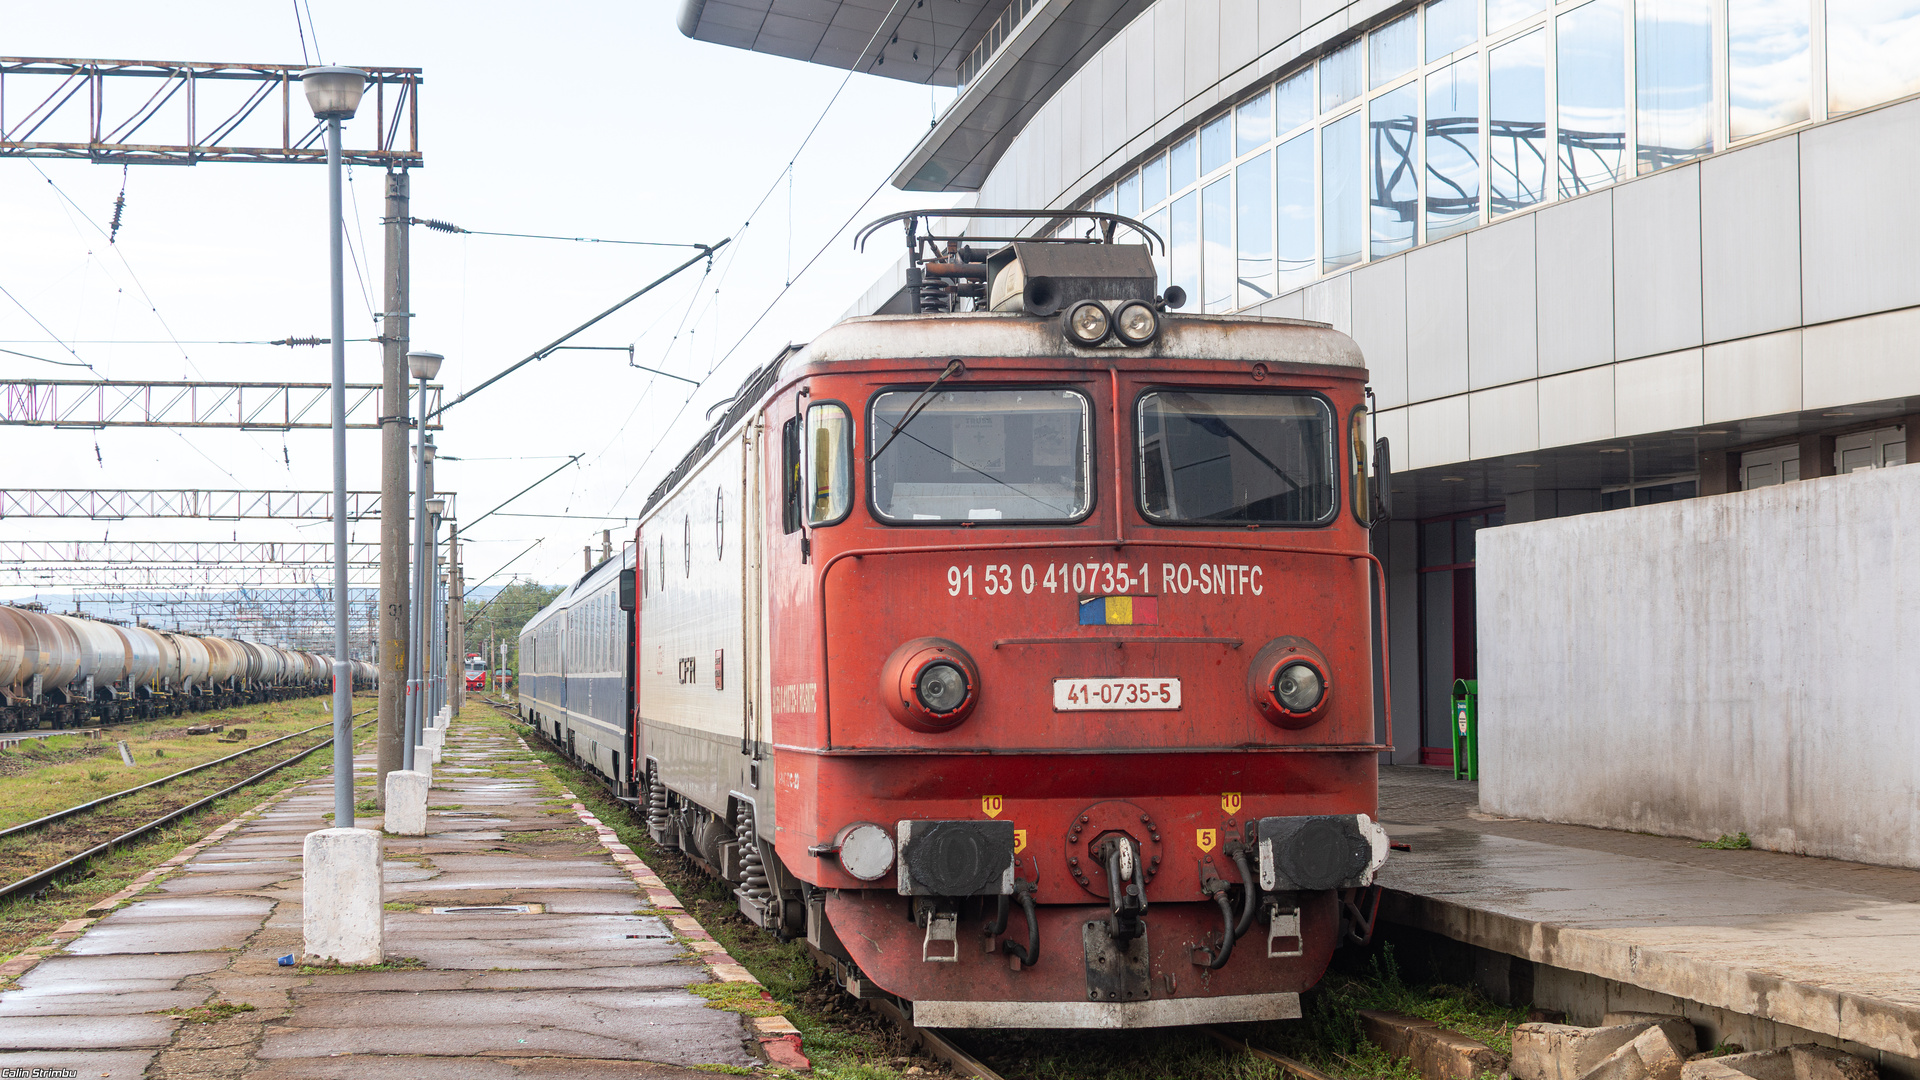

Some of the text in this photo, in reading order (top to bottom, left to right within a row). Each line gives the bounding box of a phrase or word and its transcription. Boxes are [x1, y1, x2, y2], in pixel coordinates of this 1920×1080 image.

[947, 562, 1263, 596] 91 53 0 410735-1 RO-SNTFC
[1067, 683, 1171, 704] 41-0735-5
[983, 796, 1001, 810] 10
[1222, 794, 1240, 808] 10
[1014, 833, 1021, 848] 5
[1202, 831, 1212, 846] 5
